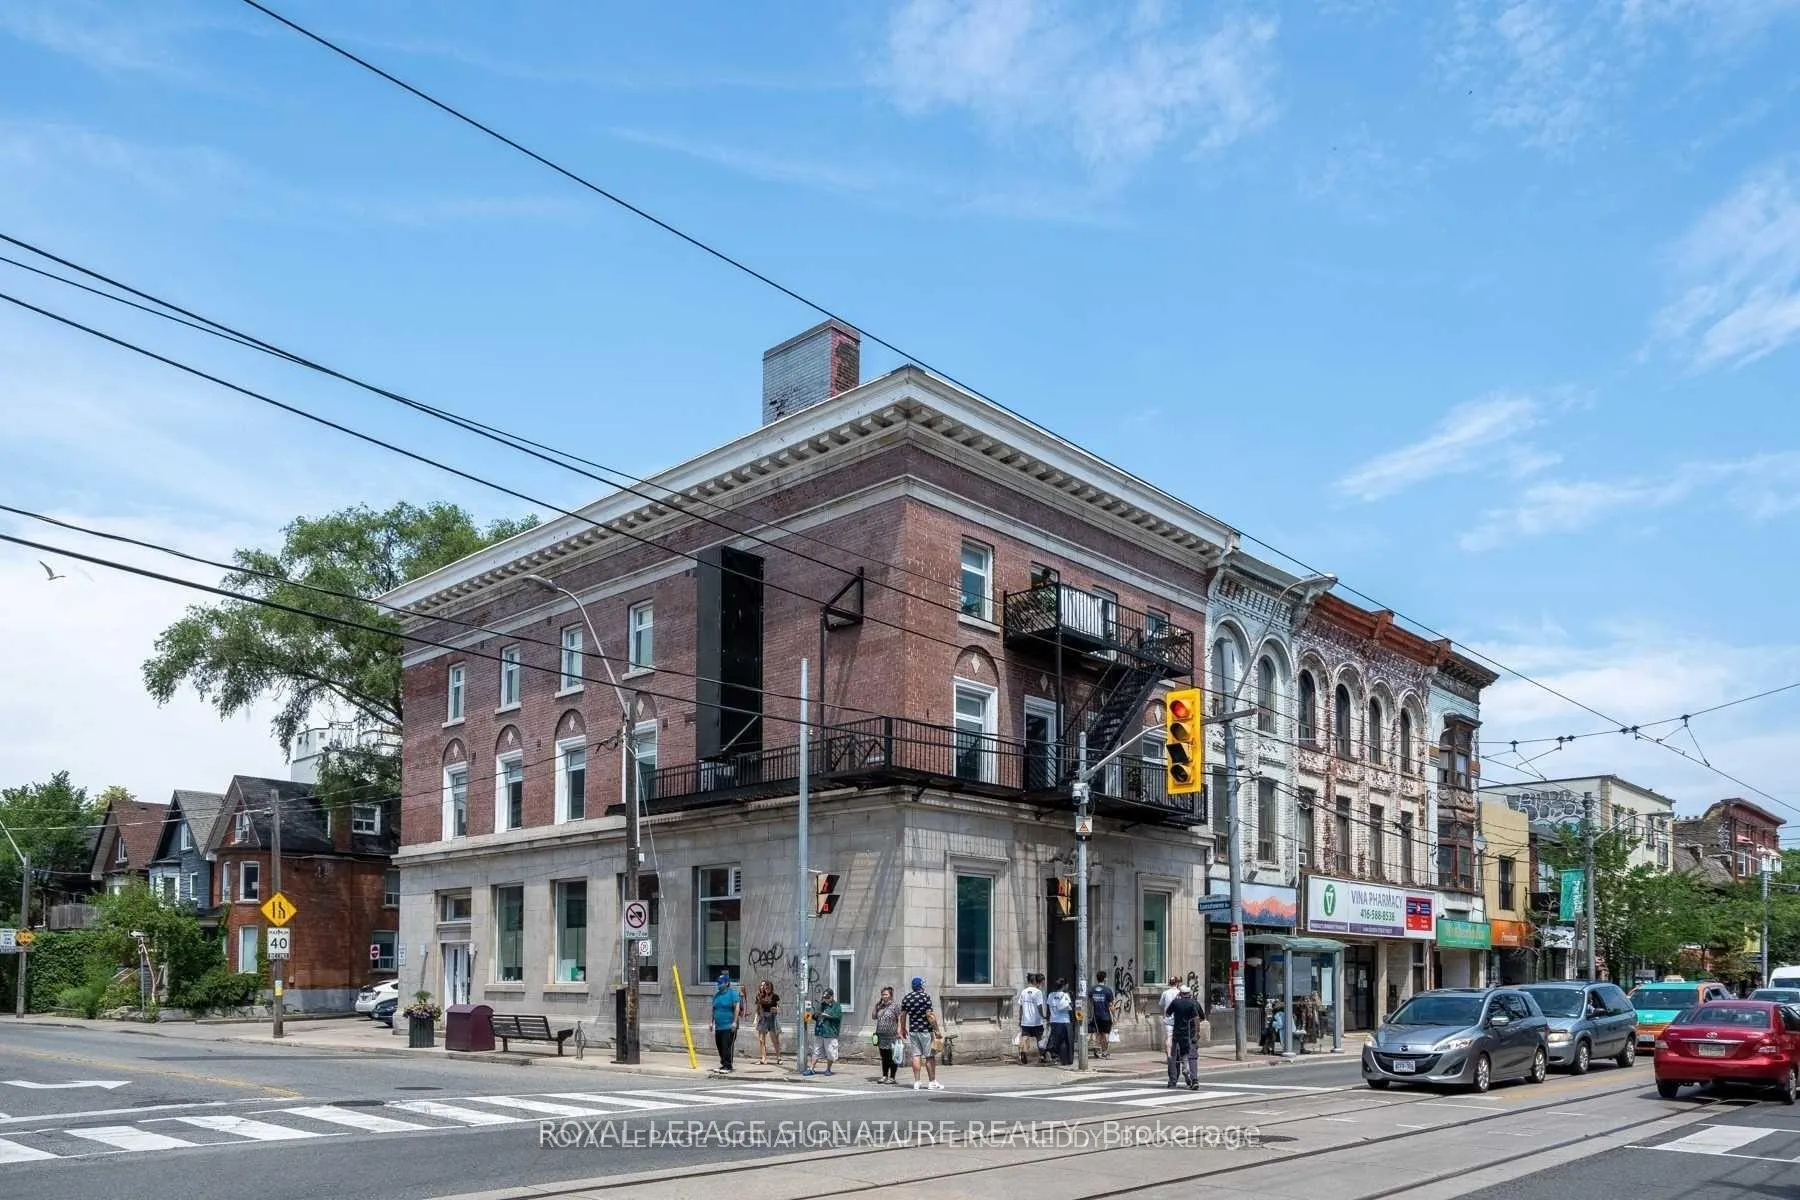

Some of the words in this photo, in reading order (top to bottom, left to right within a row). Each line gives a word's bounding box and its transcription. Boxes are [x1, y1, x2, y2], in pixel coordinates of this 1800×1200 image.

[1351, 890, 1367, 905] VINA
[1368, 891, 1403, 909] PHARMACY
[270, 938, 287, 949] 40
